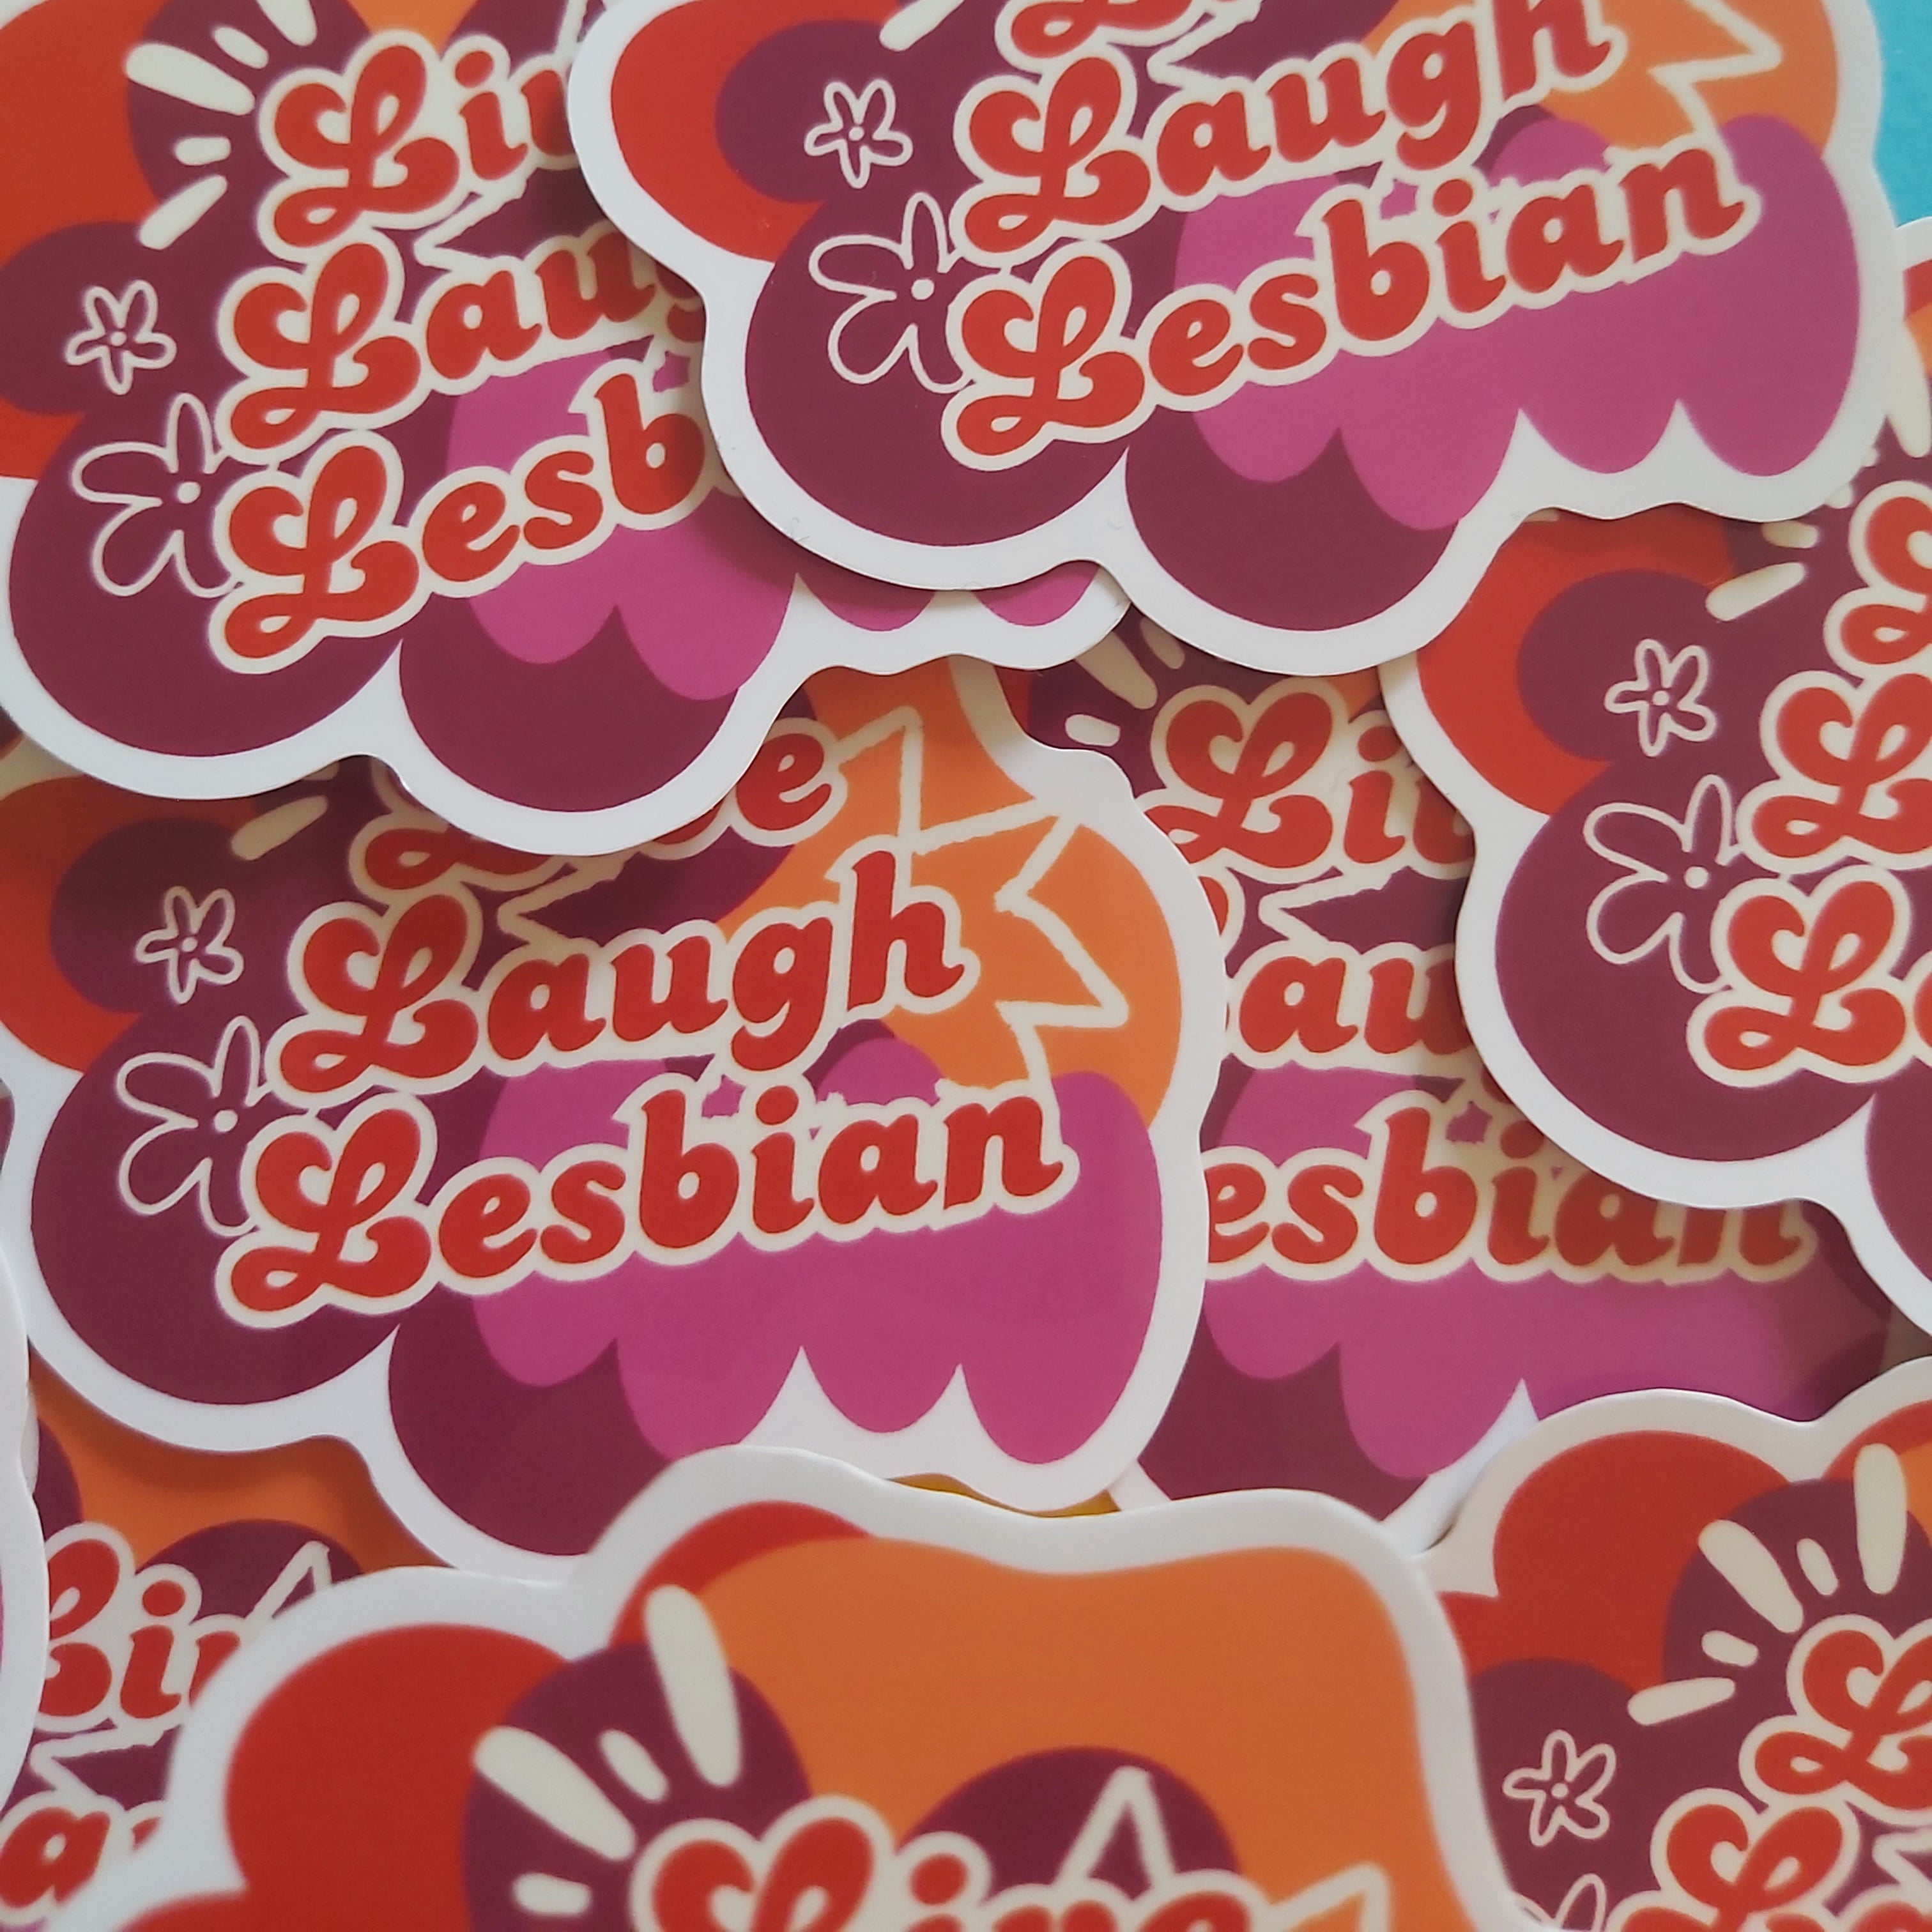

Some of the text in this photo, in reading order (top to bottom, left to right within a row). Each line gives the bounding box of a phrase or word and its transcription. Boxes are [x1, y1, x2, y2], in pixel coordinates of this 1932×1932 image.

[963, 0, 1611, 254] Laugh
[956, 148, 1745, 457] Lesbian
[279, 850, 965, 1094] Laugh
[229, 1085, 1064, 1313] Lesbian
